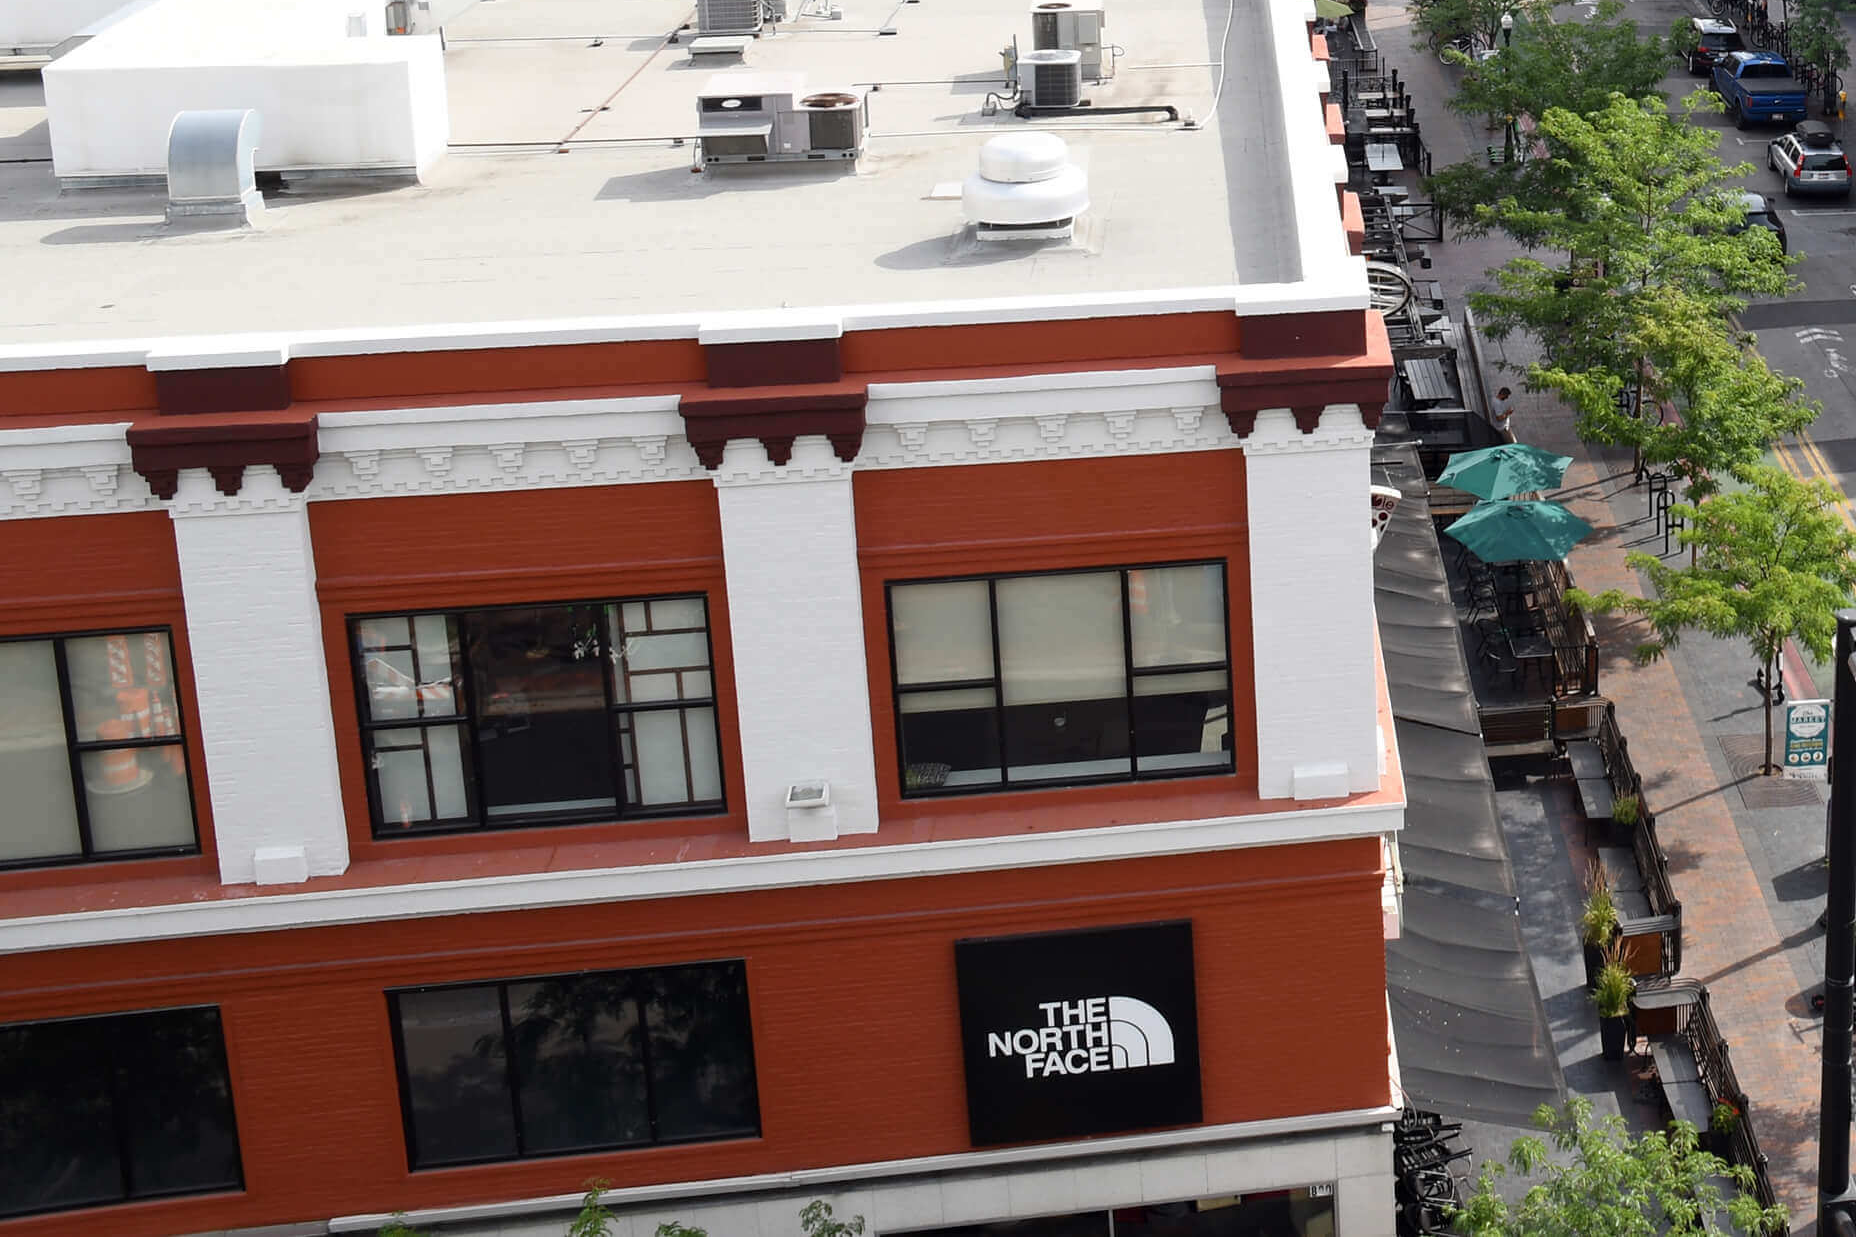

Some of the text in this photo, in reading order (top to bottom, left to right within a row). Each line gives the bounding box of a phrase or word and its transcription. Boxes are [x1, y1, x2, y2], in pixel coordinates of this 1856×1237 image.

[1038, 996, 1108, 1027] THE
[987, 1021, 1110, 1058] NORTH
[1025, 1046, 1112, 1079] FACE
